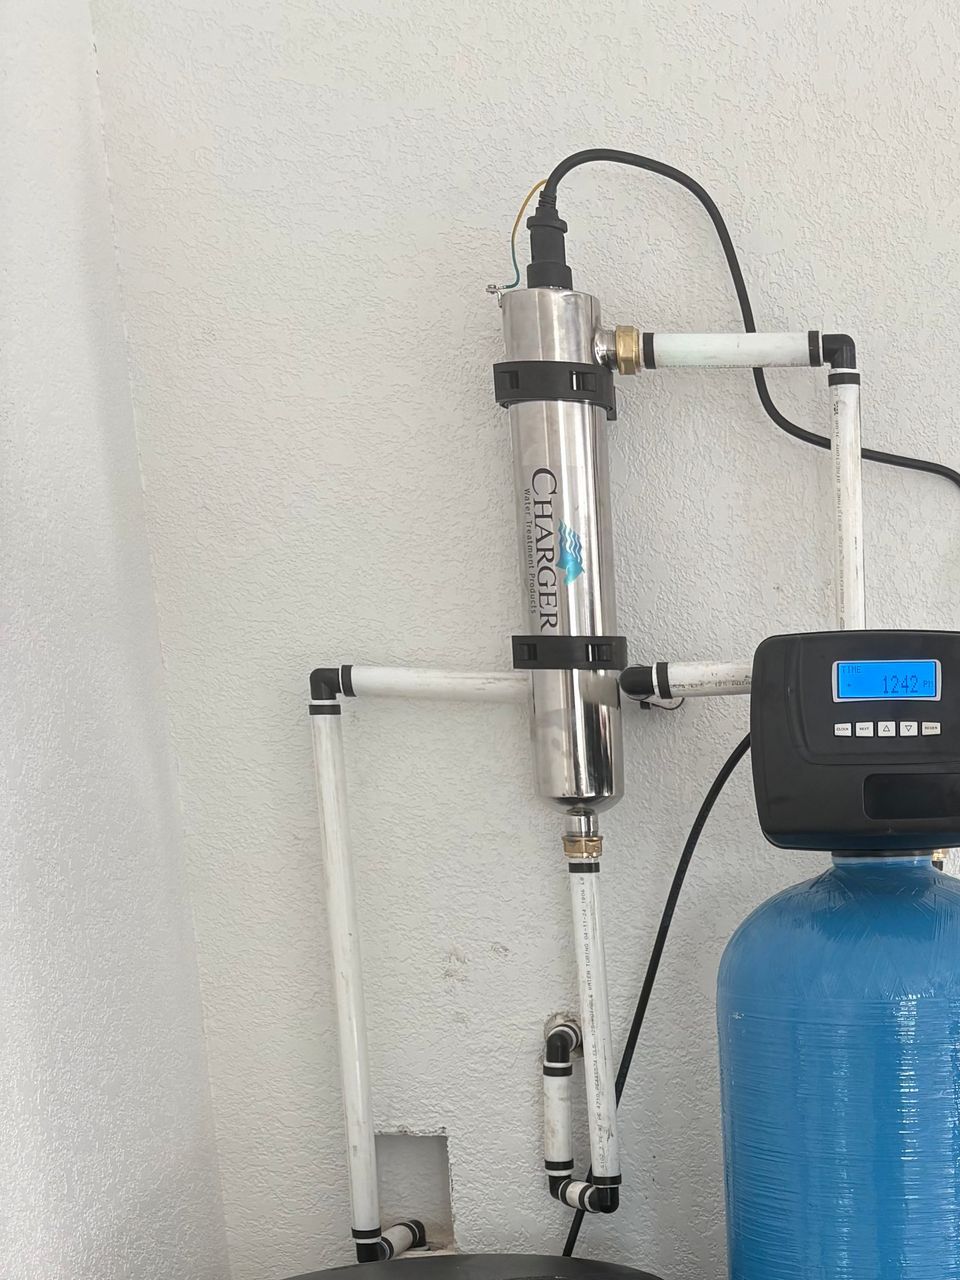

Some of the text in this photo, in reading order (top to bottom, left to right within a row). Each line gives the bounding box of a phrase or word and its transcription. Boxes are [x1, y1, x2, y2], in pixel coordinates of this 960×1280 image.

[524, 488, 538, 615] Water Treatment Products
[532, 467, 558, 632] CHARGER
[842, 665, 862, 674] TIME
[883, 675, 918, 693] 1242
